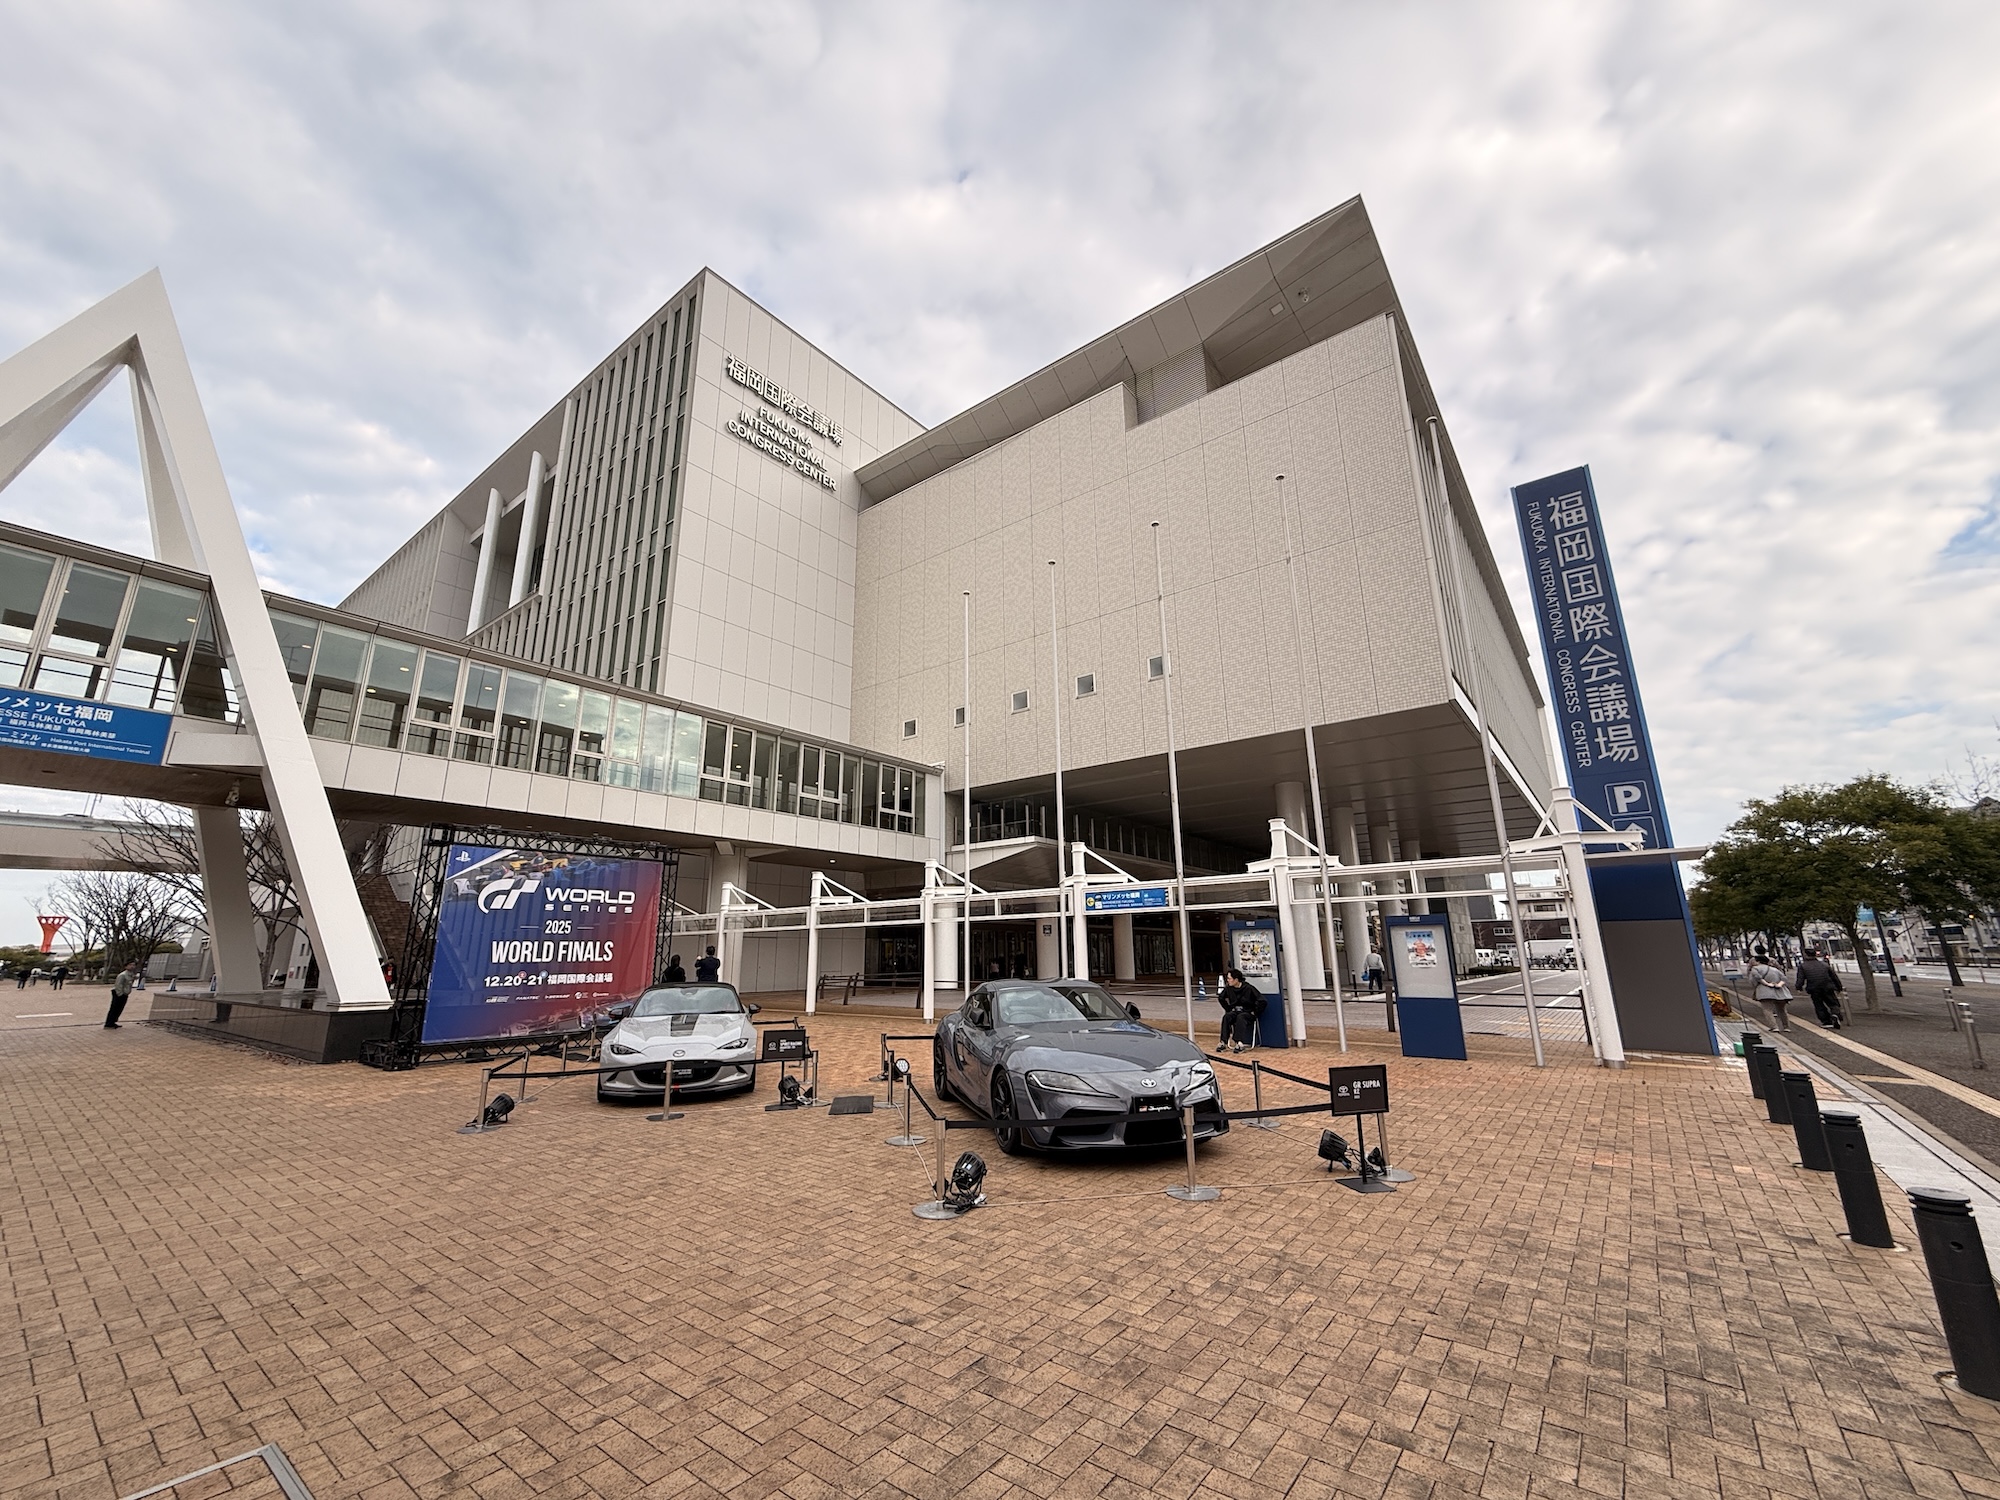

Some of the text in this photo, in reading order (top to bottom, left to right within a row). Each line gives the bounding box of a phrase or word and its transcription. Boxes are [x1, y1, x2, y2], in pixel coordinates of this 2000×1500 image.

[727, 353, 844, 447] 福岡国際会議場
[759, 406, 814, 448] FUKUOKA
[740, 410, 828, 472] INTERNATIONAL
[727, 419, 837, 492] CONGRESS CENTER
[1527, 501, 1592, 768] FUKUOKA INTERNATIONAL CONGRESS CENTER
[1547, 491, 1640, 763] 福岡国際会議場
[31, 713, 86, 728] FUKUOKA
[88, 742, 125, 752] International
[126, 747, 151, 755] Terminal
[1613, 784, 1641, 813] P
[545, 887, 635, 905] WORLD
[544, 903, 633, 914] SERIES
[544, 920, 572, 934] 2025
[491, 941, 614, 963] WORLD FINALS
[547, 973, 613, 985] 福岡国際会議場
[1353, 1080, 1380, 1088] GR SUPRA
